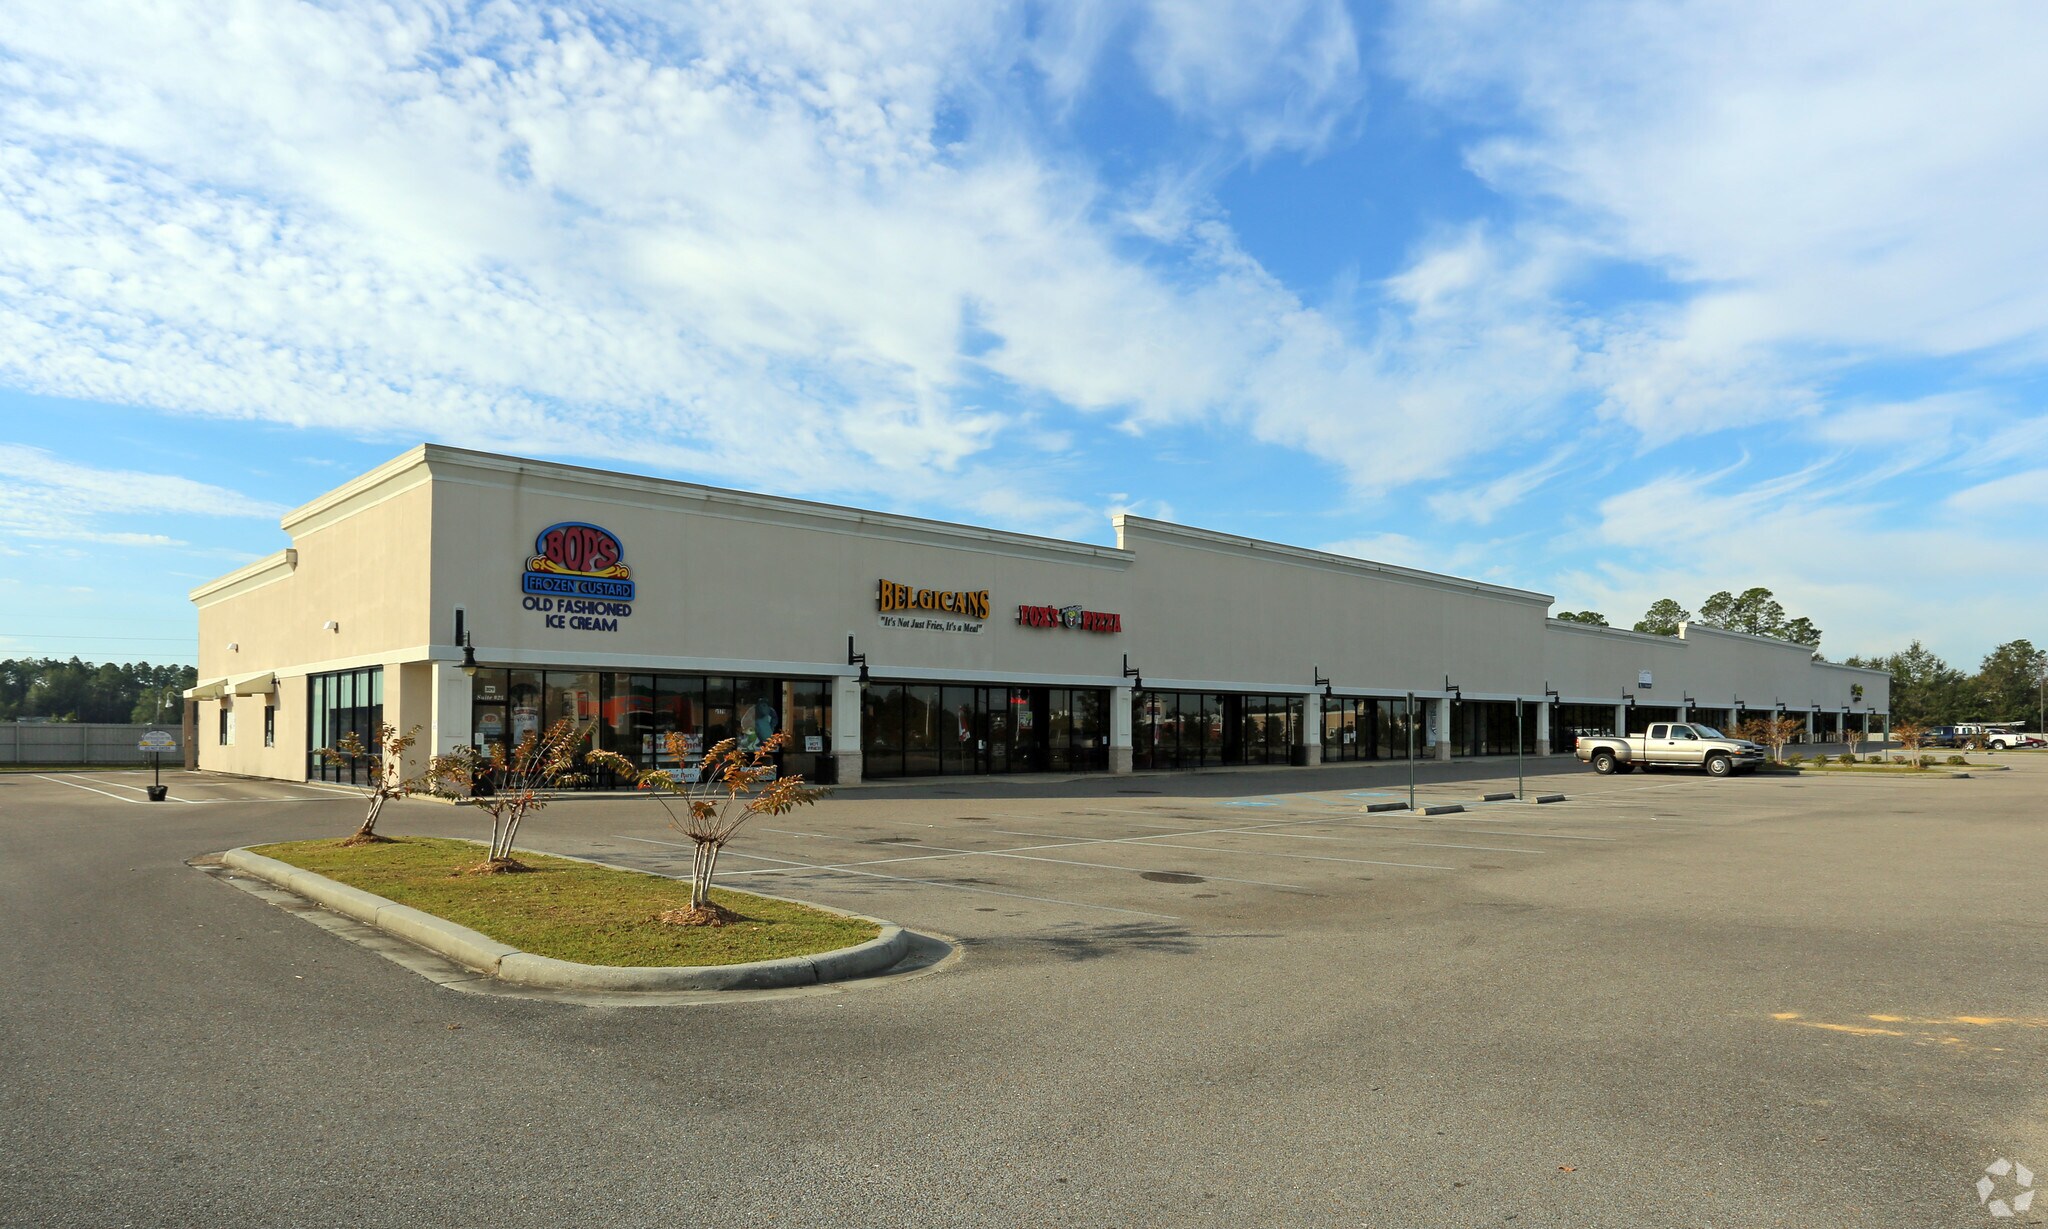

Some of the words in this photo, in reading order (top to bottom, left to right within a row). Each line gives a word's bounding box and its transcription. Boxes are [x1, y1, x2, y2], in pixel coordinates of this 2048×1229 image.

[545, 526, 618, 572] BOP'S
[529, 577, 577, 592] FROZEN
[579, 581, 631, 596] CUSTARD
[522, 596, 553, 612] OLD
[557, 599, 632, 617] FASHIONED
[879, 579, 990, 619] BELGICANS
[545, 614, 566, 629] ICE
[569, 616, 618, 632] CREAM
[897, 617, 910, 628] Not
[910, 618, 925, 629] Just
[946, 621, 956, 631] It's
[1019, 604, 1059, 628] FOX'S
[1081, 610, 1122, 633] PIZZA
